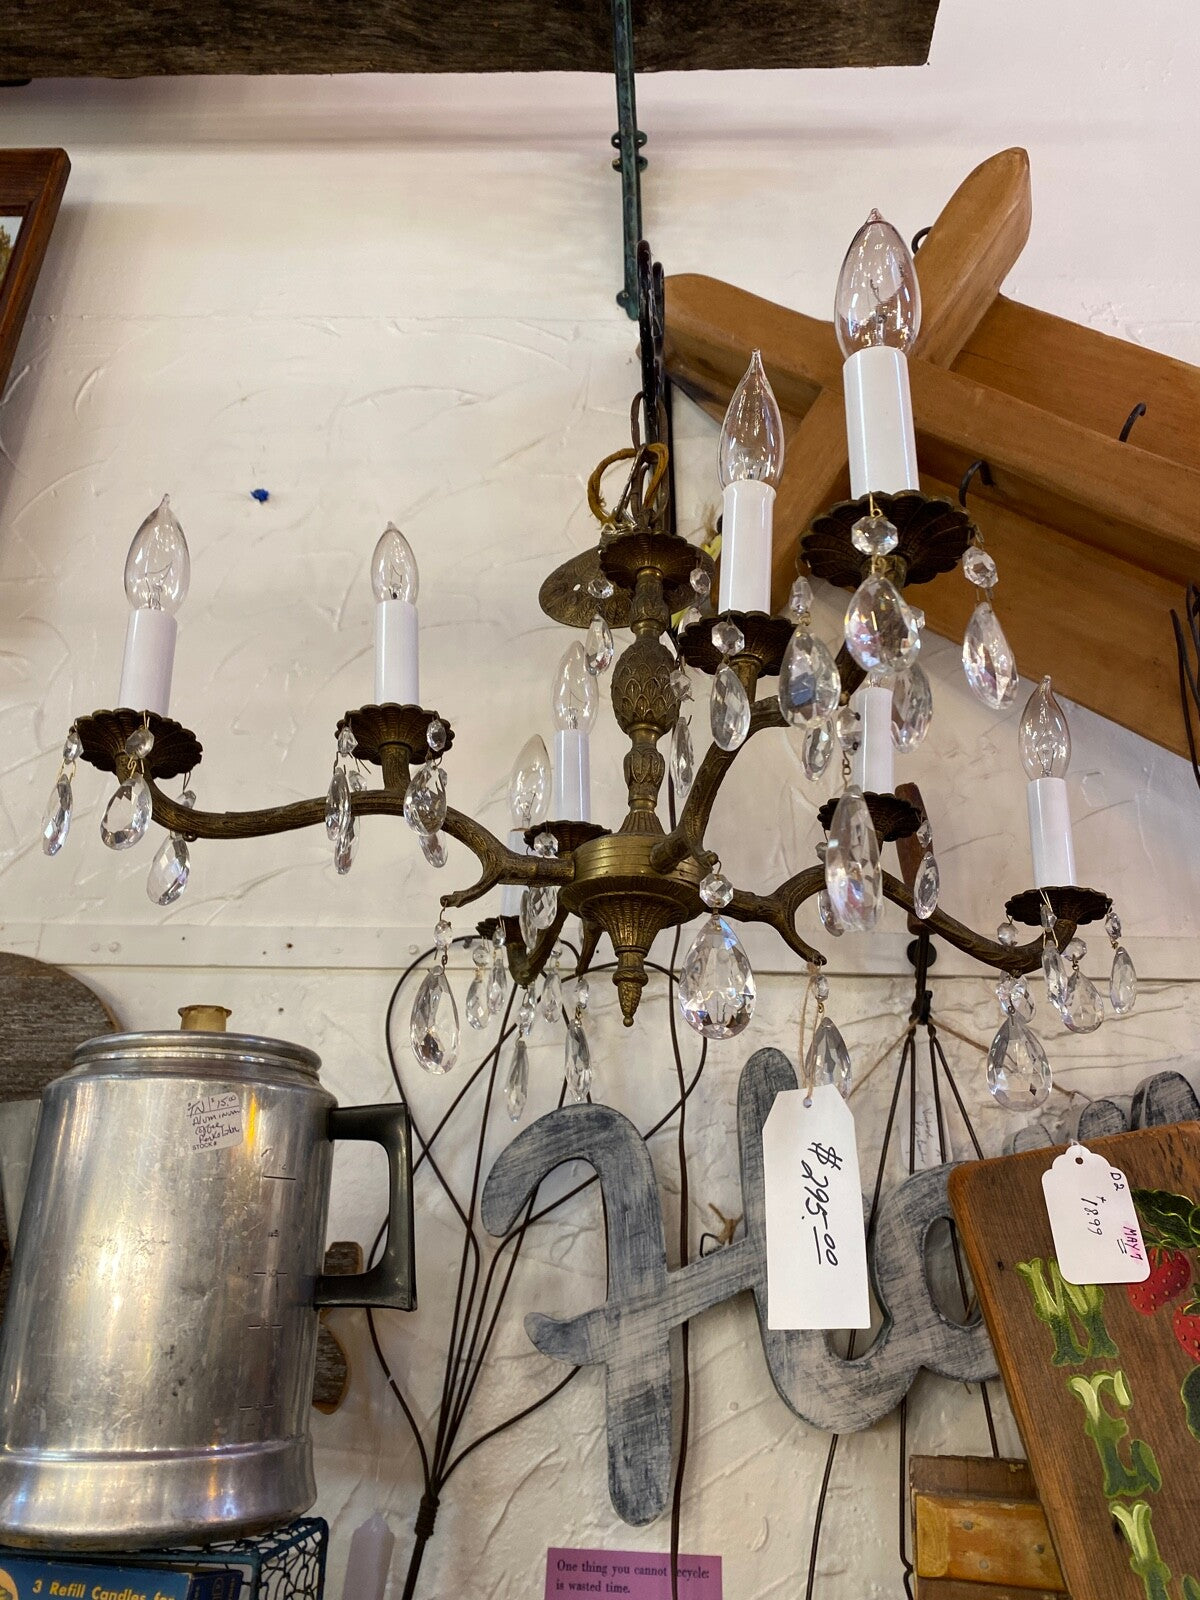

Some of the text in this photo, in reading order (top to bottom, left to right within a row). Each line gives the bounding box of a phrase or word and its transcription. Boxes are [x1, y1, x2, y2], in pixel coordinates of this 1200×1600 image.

[557, 1560, 578, 1571] One
[582, 1562, 608, 1577] thing
[612, 1567, 630, 1577] you
[634, 1567, 667, 1577] cannot
[32, 1579, 42, 1593] 3
[49, 1581, 86, 1598] Refill
[91, 1586, 146, 1600] Candles
[556, 1579, 631, 1594] is wasted time.
